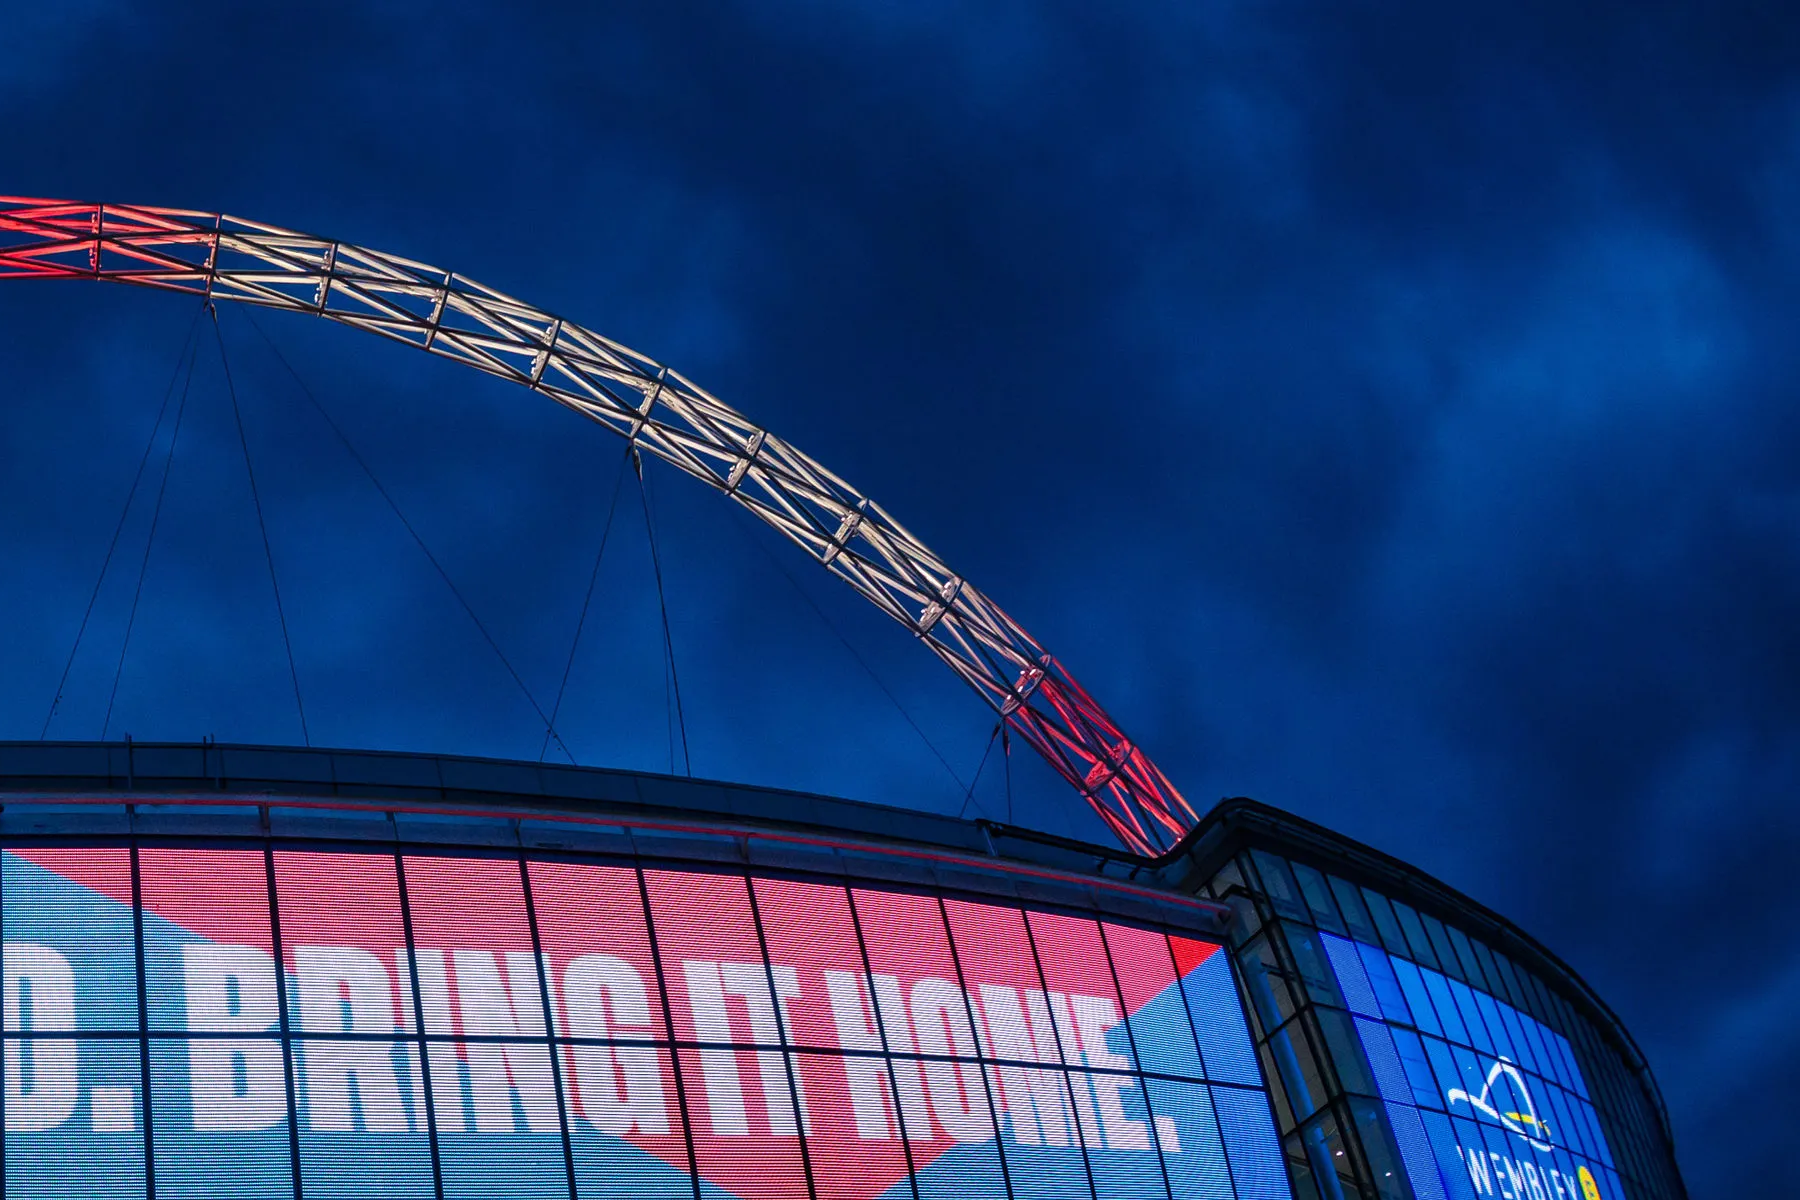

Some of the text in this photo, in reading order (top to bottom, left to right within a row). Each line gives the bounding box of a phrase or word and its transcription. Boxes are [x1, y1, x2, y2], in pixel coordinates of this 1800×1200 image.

[182, 943, 670, 1136] BRING
[682, 959, 811, 1136] IT
[824, 969, 1181, 1152] HOME.
